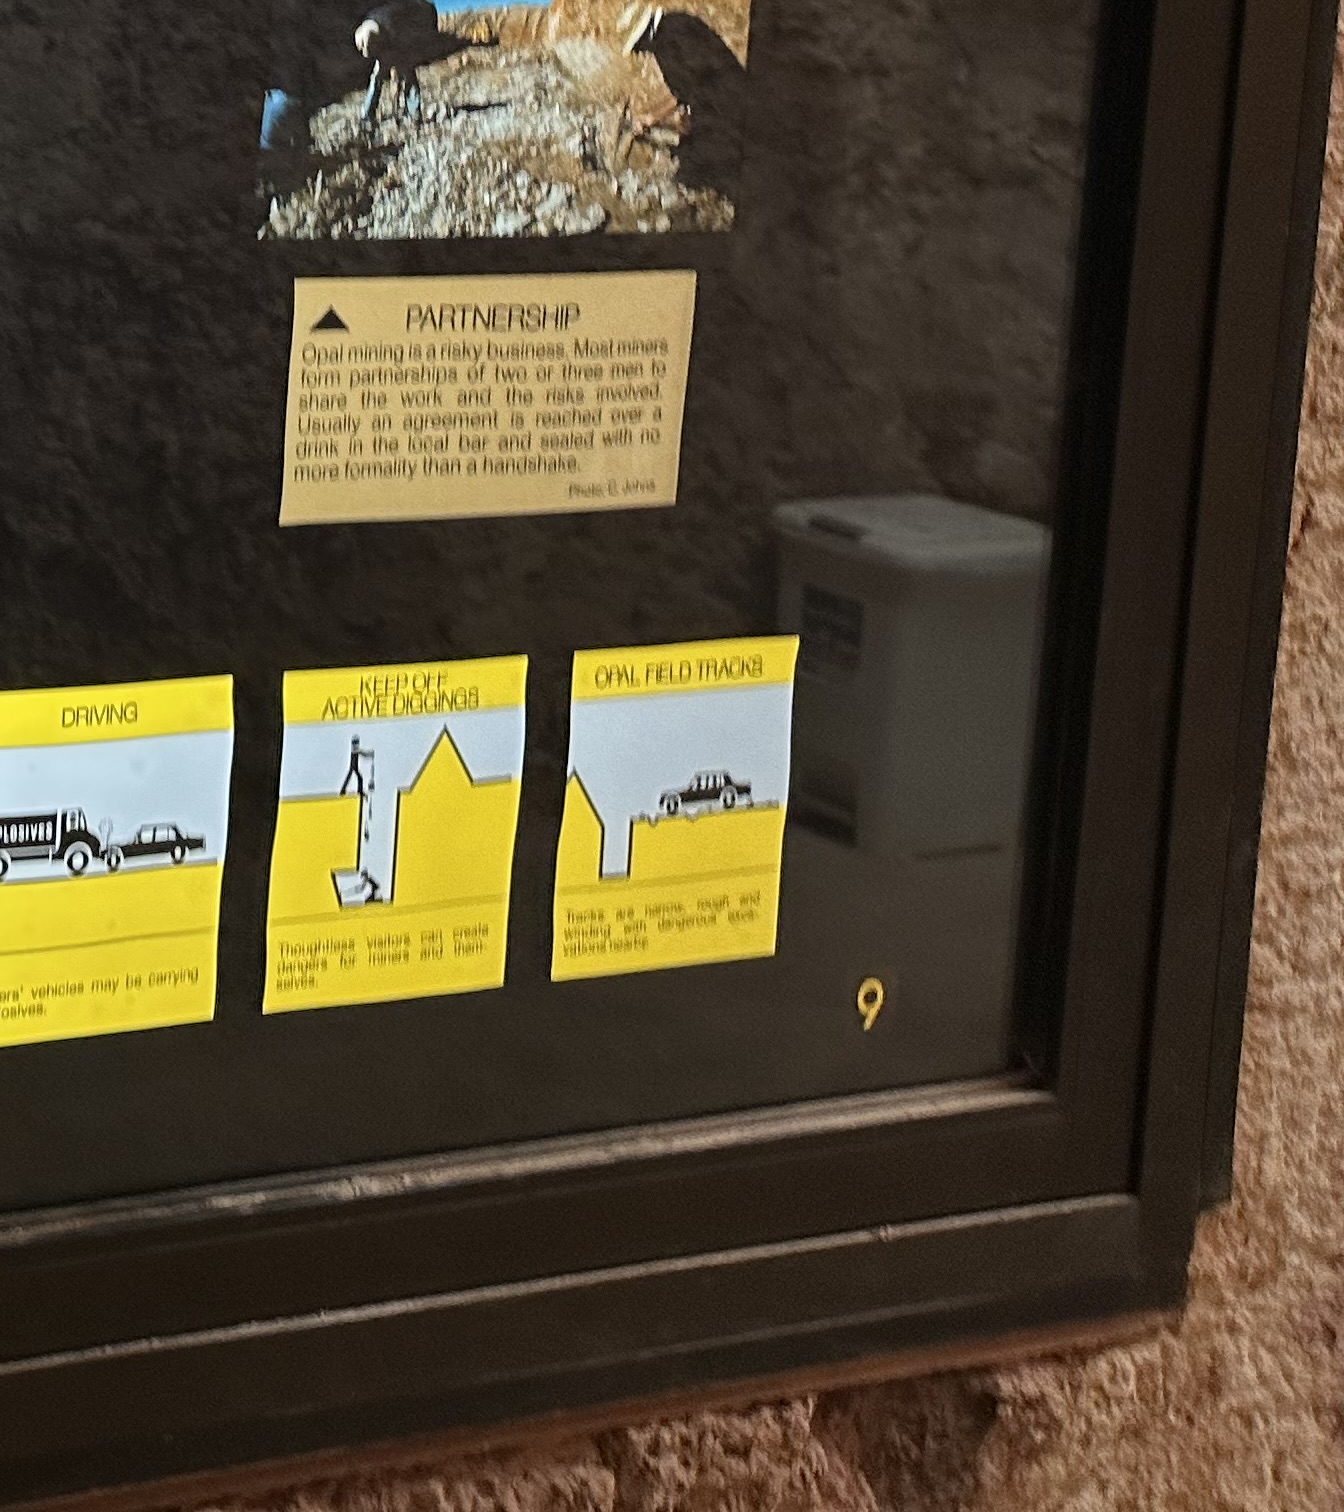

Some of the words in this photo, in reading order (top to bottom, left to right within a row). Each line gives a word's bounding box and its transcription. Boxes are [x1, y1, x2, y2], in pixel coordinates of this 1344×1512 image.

[405, 302, 581, 332] PARTNERSHIP
[61, 701, 138, 728] DRIVING
[30, 978, 84, 999] vehicles
[90, 977, 119, 995] may
[125, 971, 142, 989] be
[148, 966, 199, 989] carrying
[855, 976, 884, 1031] 9
